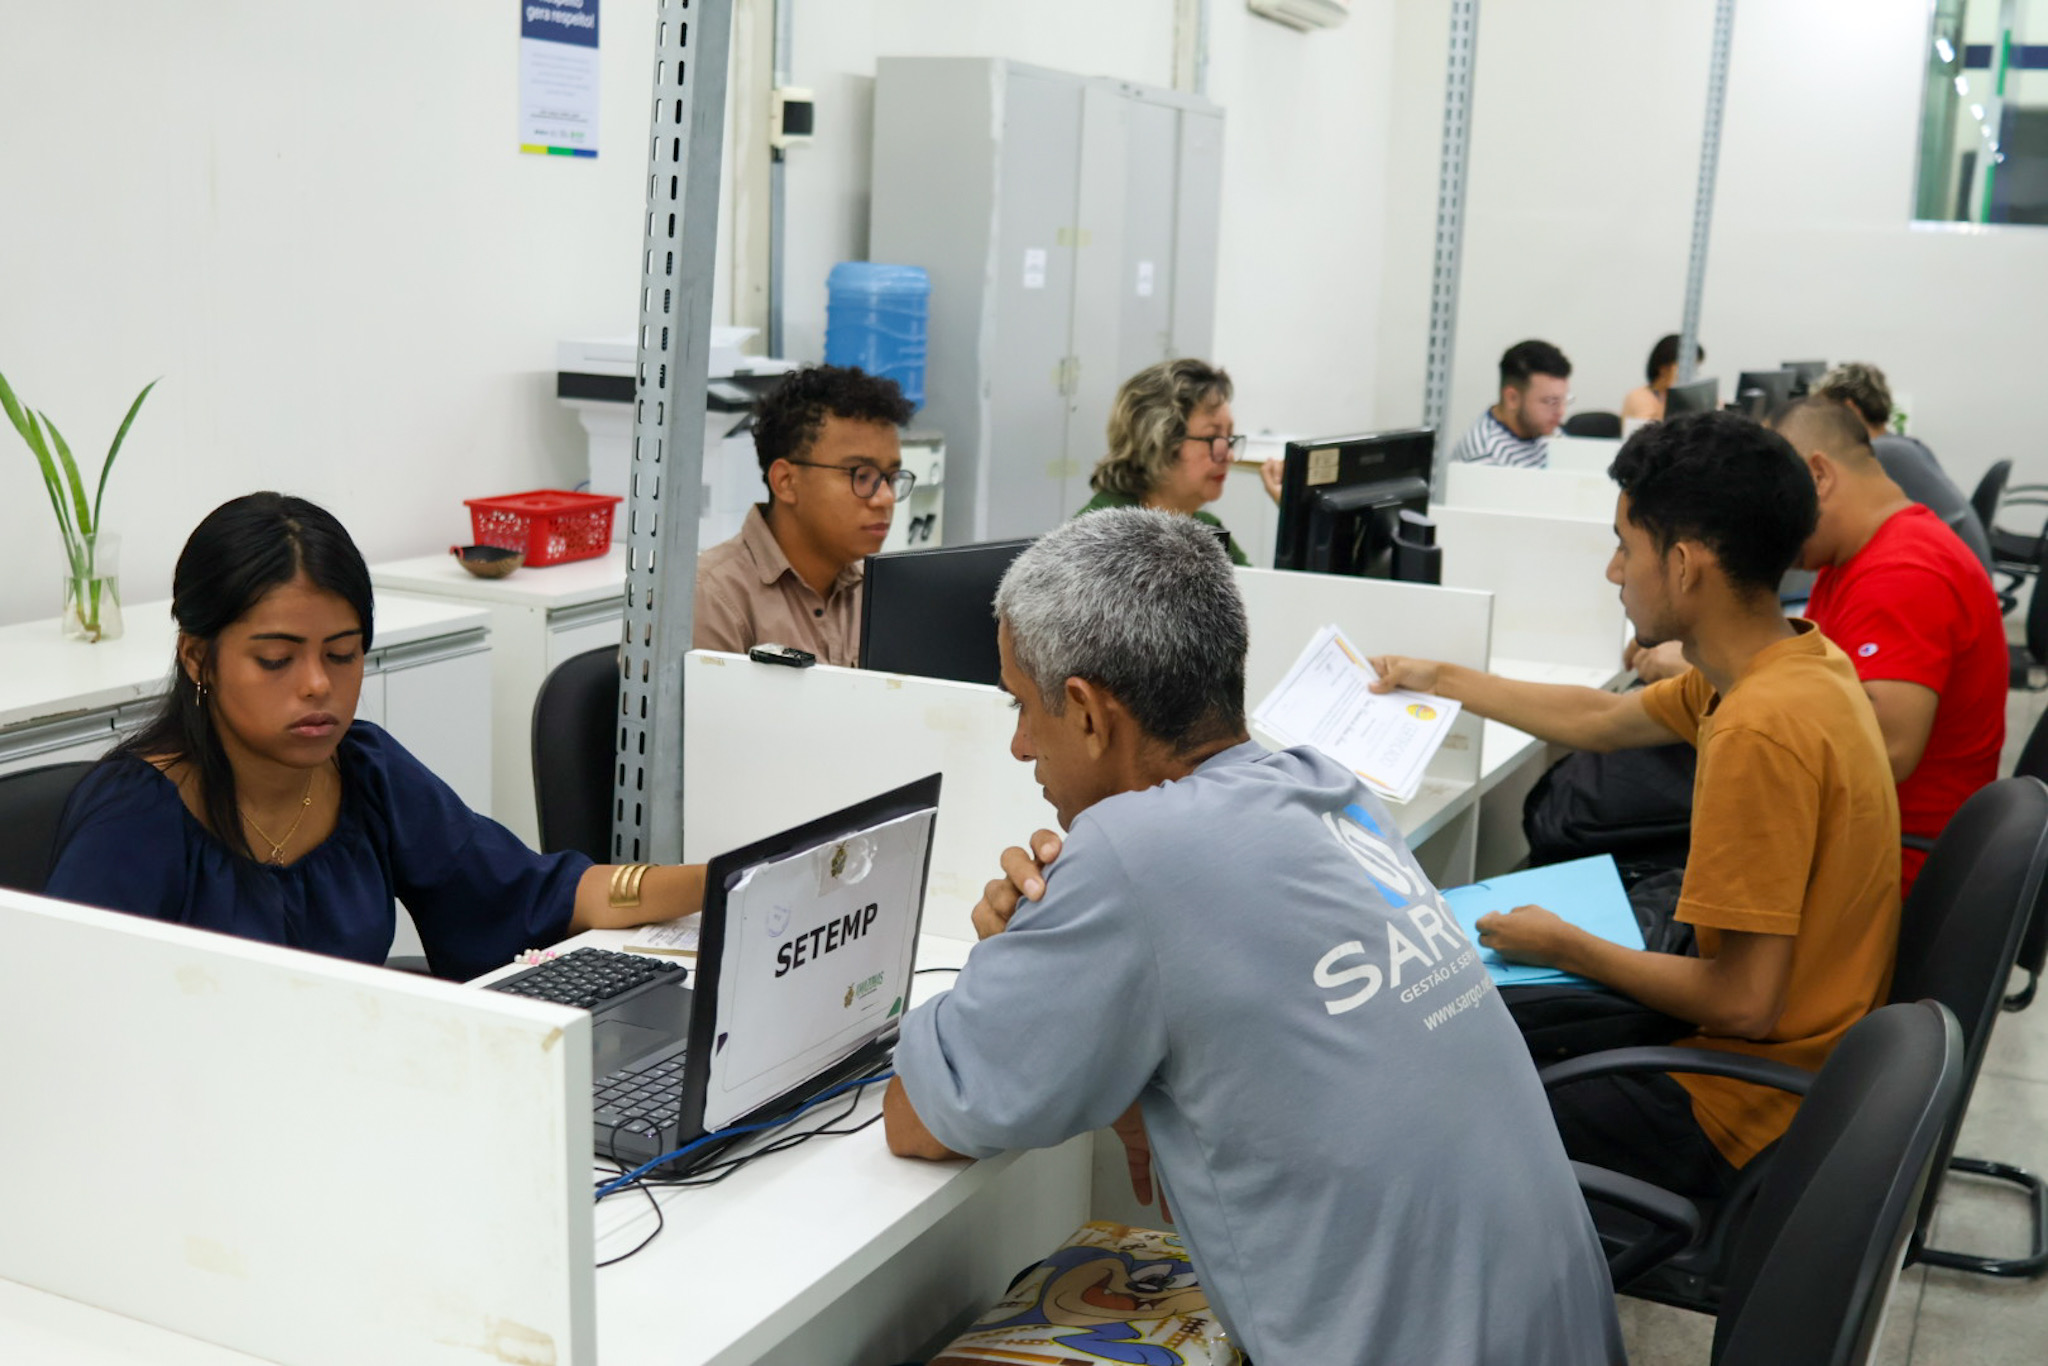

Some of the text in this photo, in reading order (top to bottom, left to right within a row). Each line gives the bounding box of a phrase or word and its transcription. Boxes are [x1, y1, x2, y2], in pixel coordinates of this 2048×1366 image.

[774, 902, 878, 978] SETEMP
[1400, 967, 1450, 1003] GESTÃO
[1449, 961, 1459, 974] E
